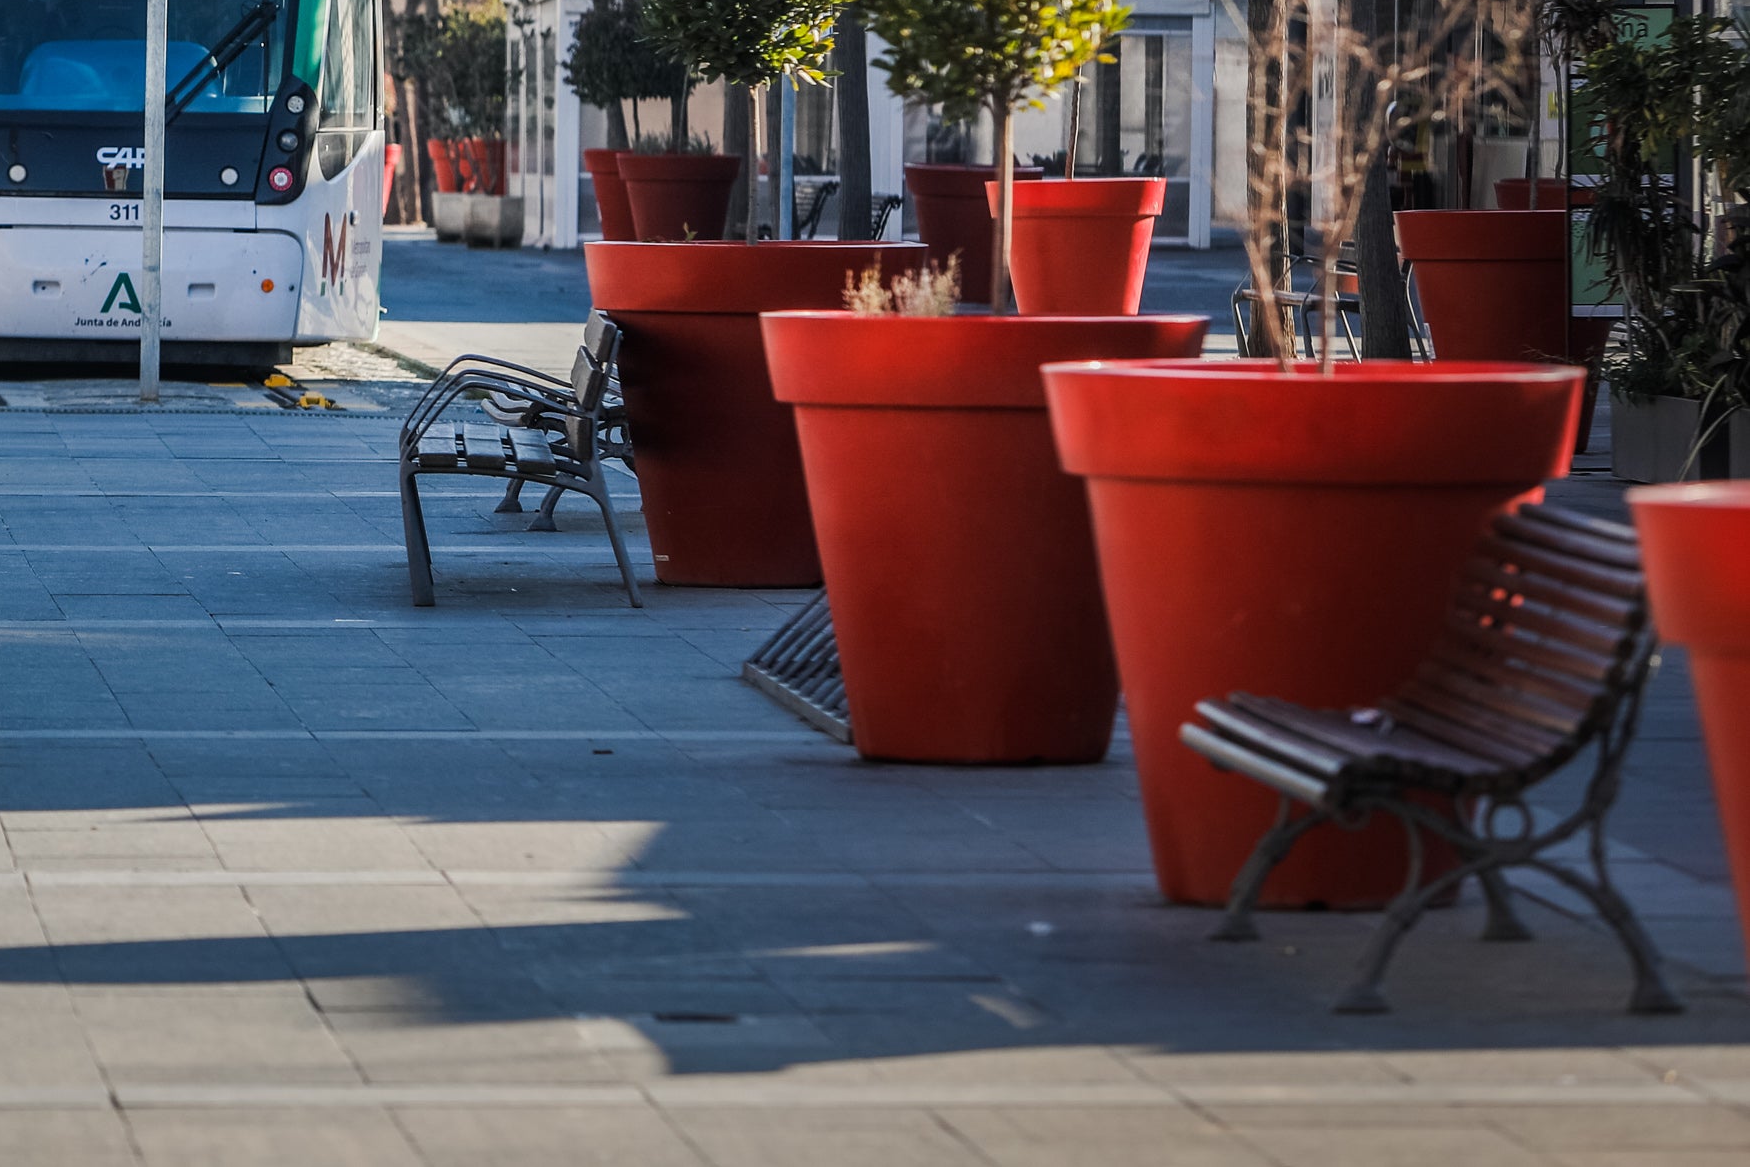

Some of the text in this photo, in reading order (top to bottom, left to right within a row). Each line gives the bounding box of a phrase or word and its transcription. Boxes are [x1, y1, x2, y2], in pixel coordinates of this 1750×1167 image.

[109, 203, 139, 221] 311
[74, 317, 172, 327] Junta de Andía
